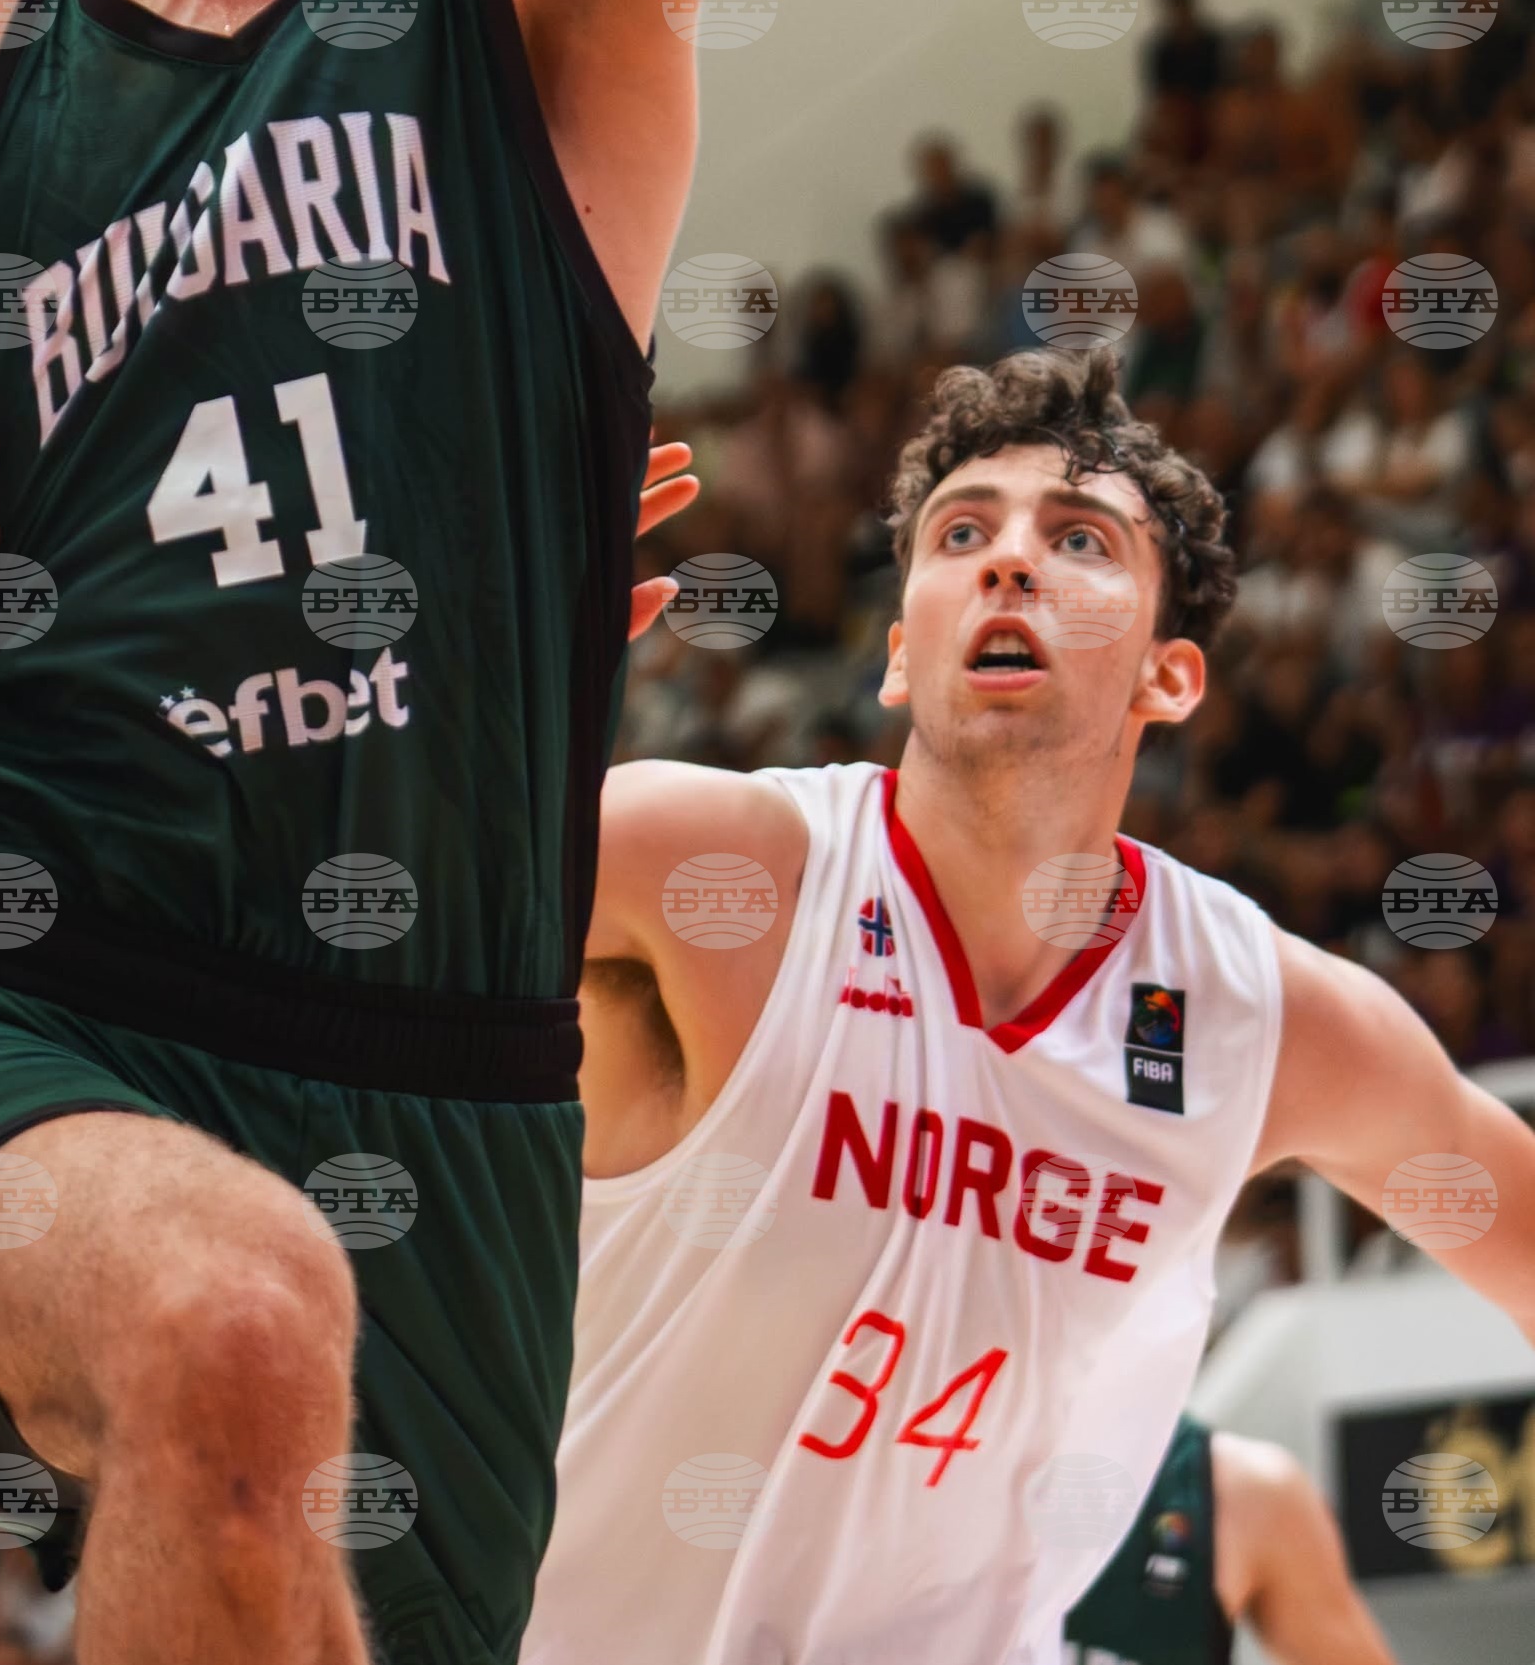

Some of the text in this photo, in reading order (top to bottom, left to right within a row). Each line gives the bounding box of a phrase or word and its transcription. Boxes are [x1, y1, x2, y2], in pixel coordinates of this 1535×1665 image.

[24, 111, 452, 451] BULGARIA
[146, 372, 368, 588] 41
[164, 647, 410, 758] efbet
[1133, 1056, 1175, 1083] FIBA
[811, 1090, 1165, 1284] NORGE
[798, 1309, 1009, 1488] 34
